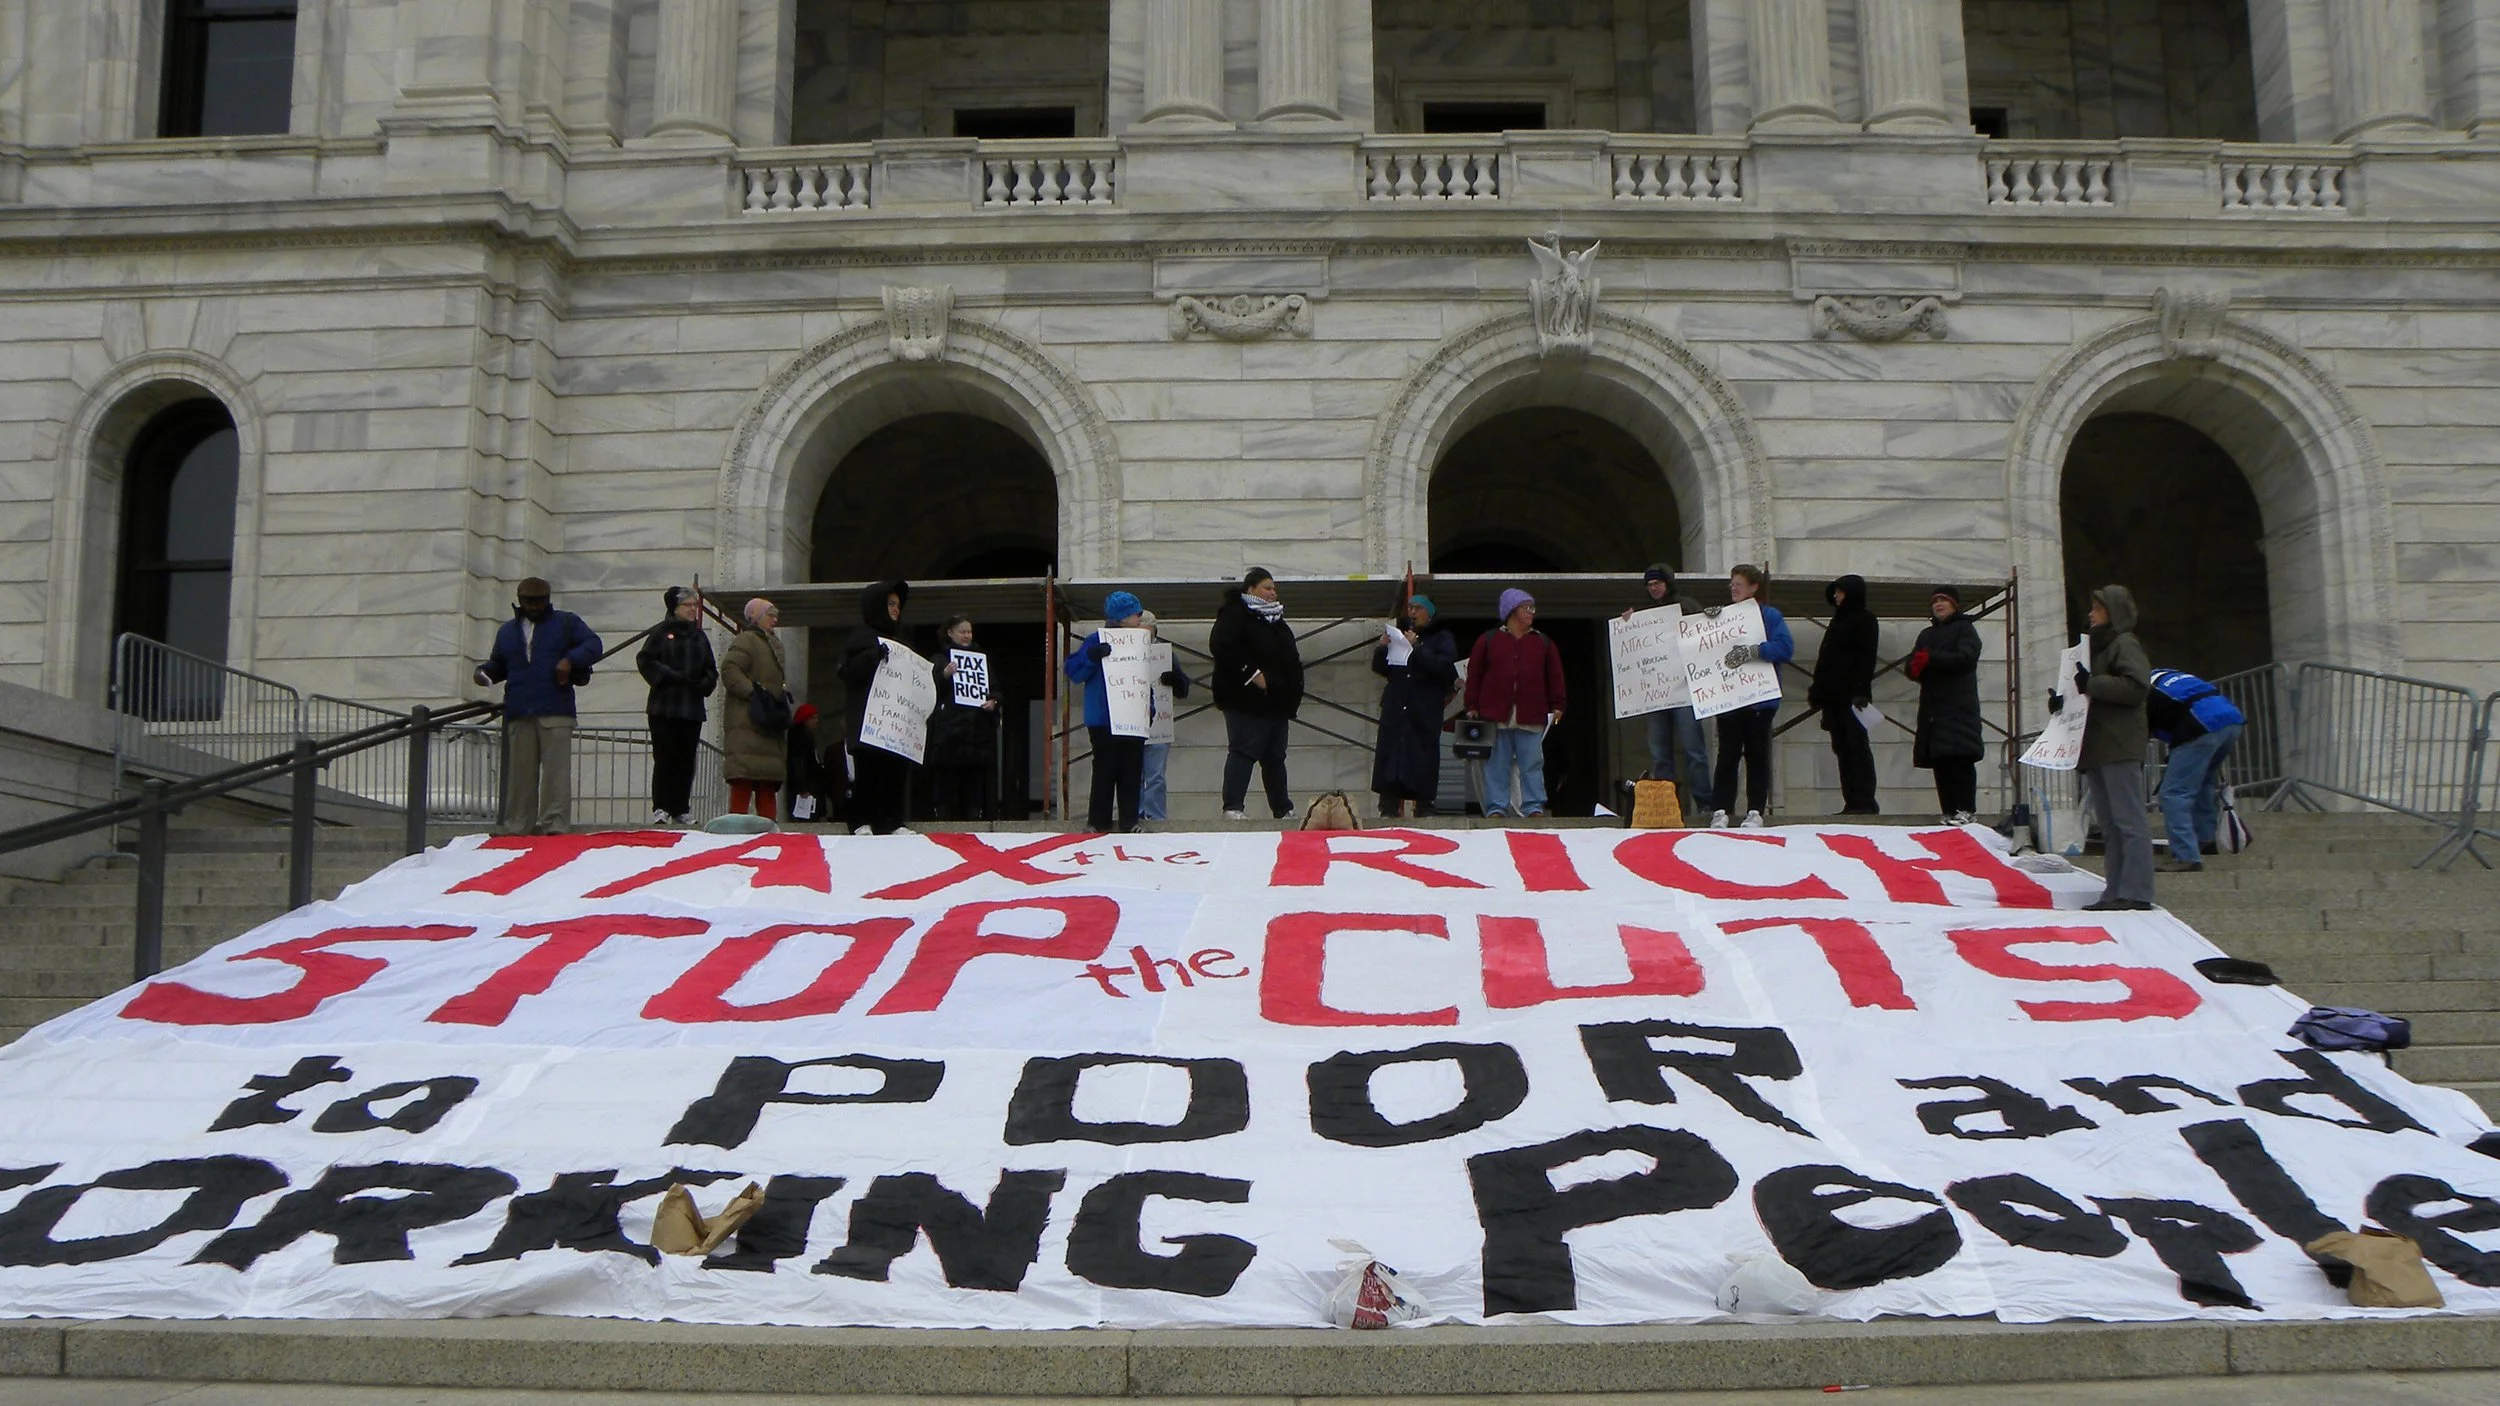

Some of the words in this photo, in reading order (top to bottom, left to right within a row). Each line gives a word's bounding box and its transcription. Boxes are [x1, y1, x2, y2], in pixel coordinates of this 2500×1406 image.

[1620, 631, 1666, 657] ATTACK
[1699, 625, 1748, 652] ATTACK
[954, 655, 984, 671] TAX
[957, 670, 986, 686] THE
[955, 682, 989, 701] RICH
[1644, 686, 1670, 703] NOW
[444, 830, 1110, 899] TAX
[1060, 844, 1210, 867] the
[1269, 828, 2055, 909] RICH
[117, 896, 1121, 1026] STOP
[1076, 945, 1250, 998] the
[1259, 911, 2204, 1027] CUTS
[207, 1055, 481, 1134] to
[662, 1019, 1822, 1150] POOR
[1895, 1048, 2438, 1139] and
[0, 1154, 1258, 1297] ORKING
[1465, 1118, 2500, 1318] People
